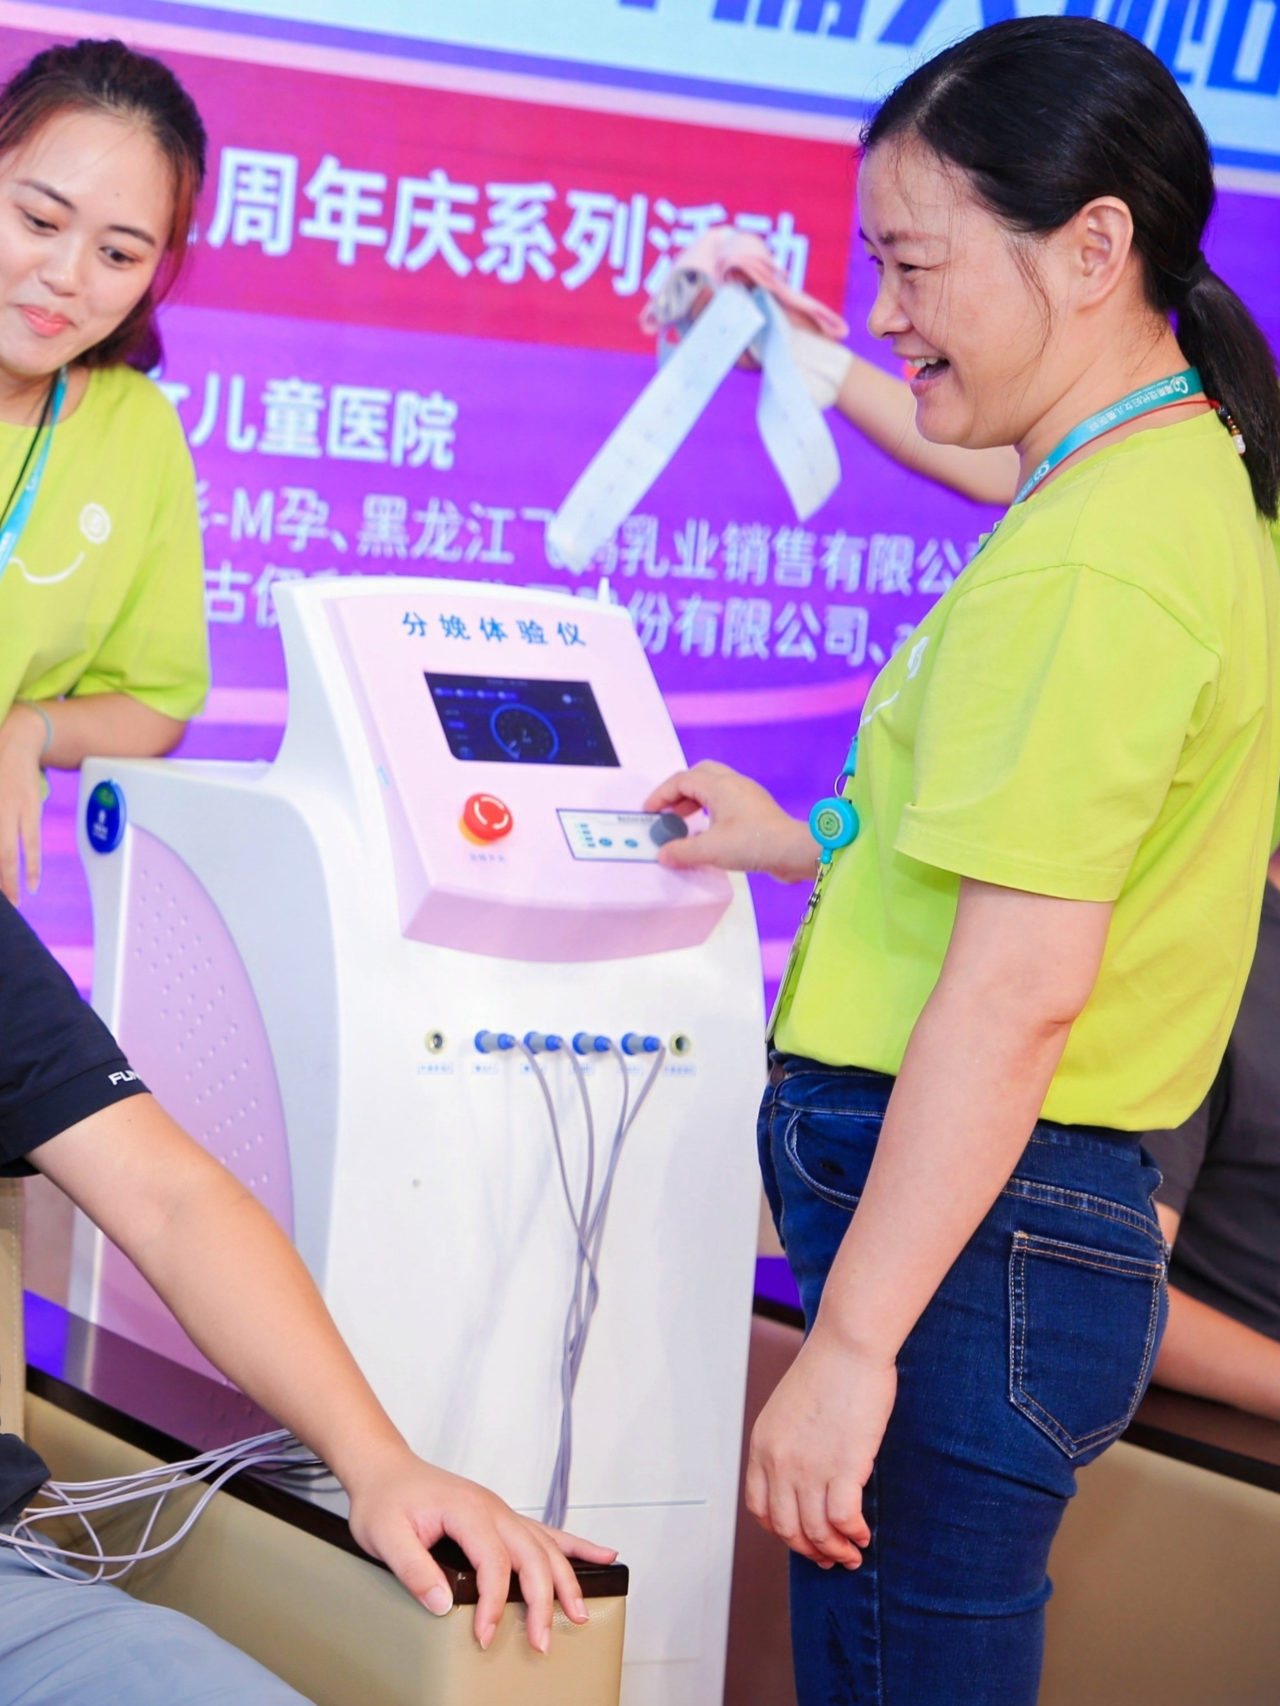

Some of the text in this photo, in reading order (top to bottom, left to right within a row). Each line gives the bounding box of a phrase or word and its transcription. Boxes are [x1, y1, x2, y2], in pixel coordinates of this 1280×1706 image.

[148, 366, 460, 471] 儿童医院
[401, 610, 588, 647] 分娩体验仪
